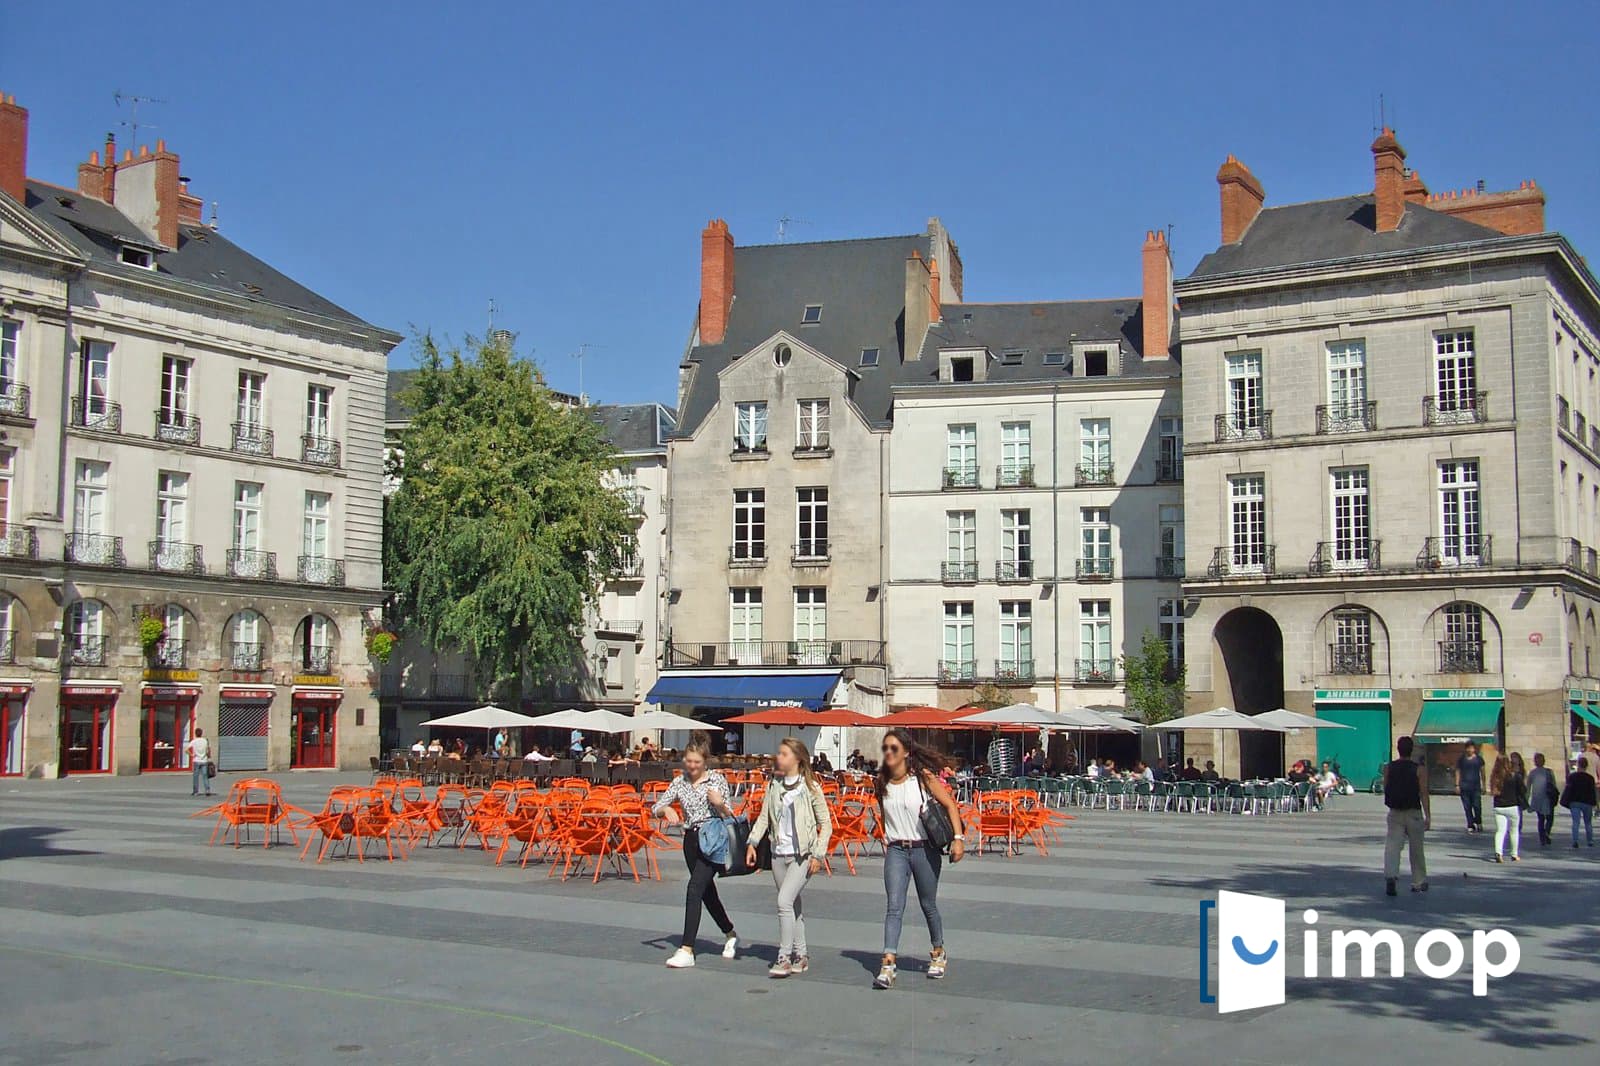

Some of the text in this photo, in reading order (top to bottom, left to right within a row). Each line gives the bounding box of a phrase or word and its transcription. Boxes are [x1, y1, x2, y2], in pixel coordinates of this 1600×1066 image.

[1326, 690, 1379, 698] ANIMALERIE
[1448, 690, 1488, 698] OISEAUX
[770, 699, 803, 708] Bouffay
